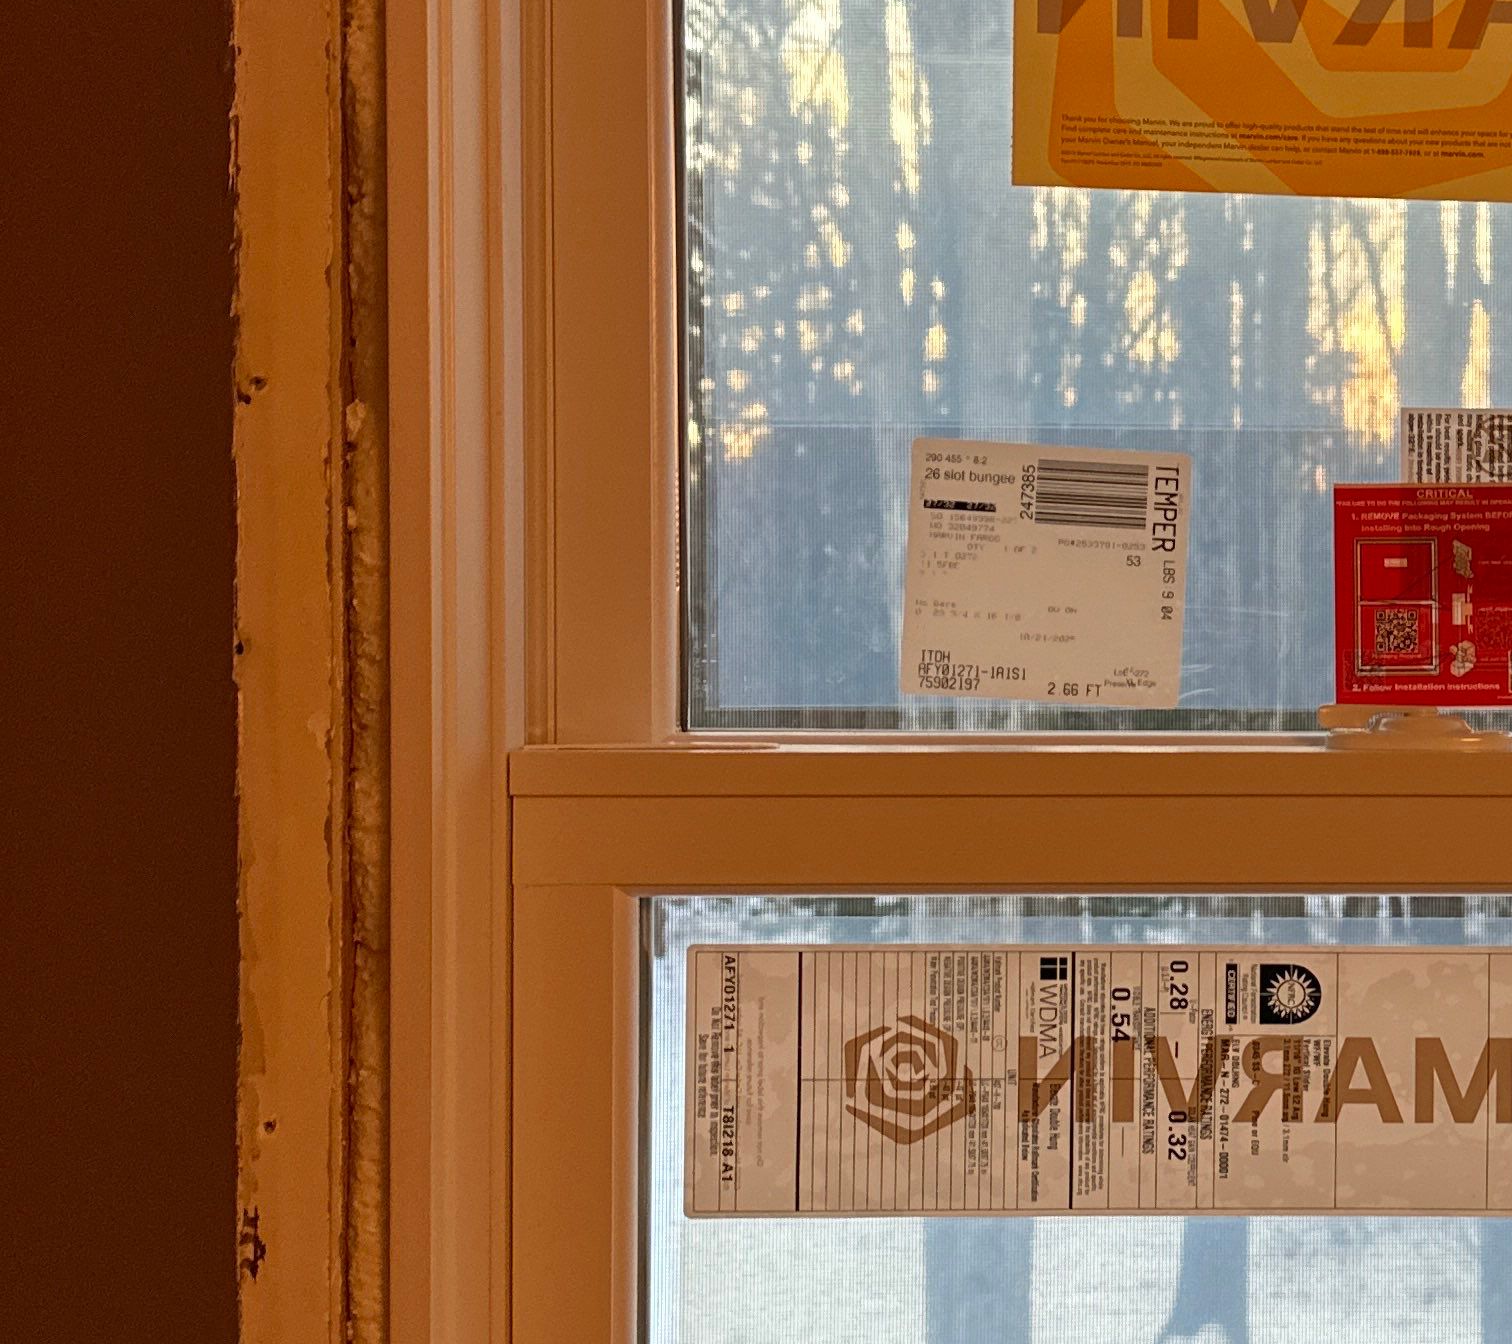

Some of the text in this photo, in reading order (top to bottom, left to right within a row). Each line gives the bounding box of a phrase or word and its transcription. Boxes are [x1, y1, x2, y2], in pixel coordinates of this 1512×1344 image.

[925, 467, 1016, 485] 26 slot bungee
[1020, 464, 1036, 520] 247385
[1417, 488, 1473, 498] CRITICAL
[1151, 464, 1180, 553] TEMPER
[1361, 511, 1400, 520] REMOVE
[1402, 512, 1449, 522] Packaging
[1450, 511, 1482, 521] System
[1424, 523, 1451, 532] Rough
[1454, 523, 1490, 532] Opening
[1126, 555, 1141, 567] 53
[918, 675, 980, 691] 75902197
[1086, 683, 1101, 697] FT
[724, 955, 736, 1030] AFY01271
[1169, 960, 1189, 1010] 0.28
[1287, 982, 1296, 1006] NFRC
[1039, 983, 1058, 1059] WDMA
[1112, 987, 1131, 1043] 0.54
[1142, 1119, 1154, 1154] RATINGS
[1168, 1111, 1187, 1160] 0.32
